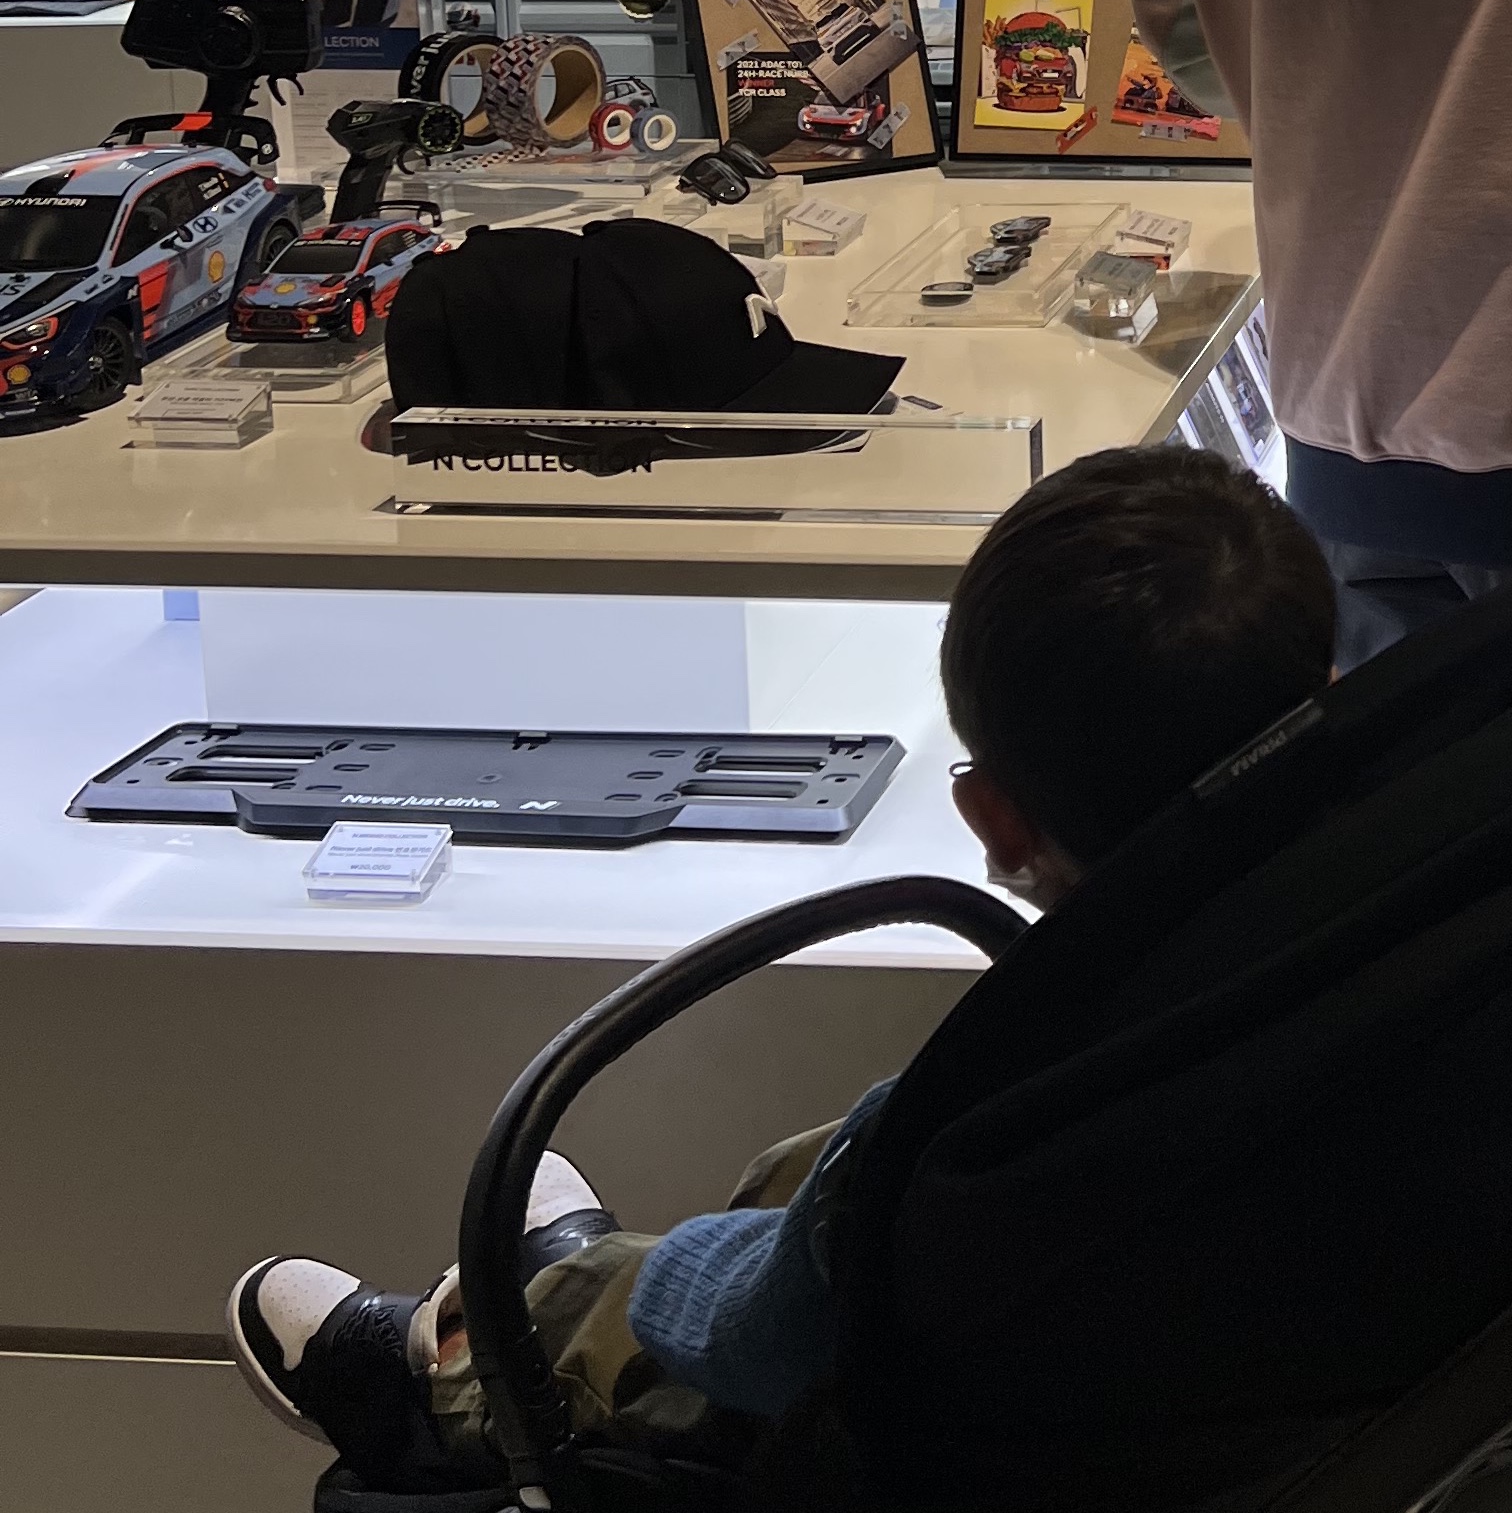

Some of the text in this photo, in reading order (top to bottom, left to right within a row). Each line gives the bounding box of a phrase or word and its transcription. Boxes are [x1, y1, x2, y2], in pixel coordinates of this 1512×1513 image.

[461, 452, 652, 473] COLLECN
[341, 794, 402, 805] Never
[401, 796, 444, 807] just
